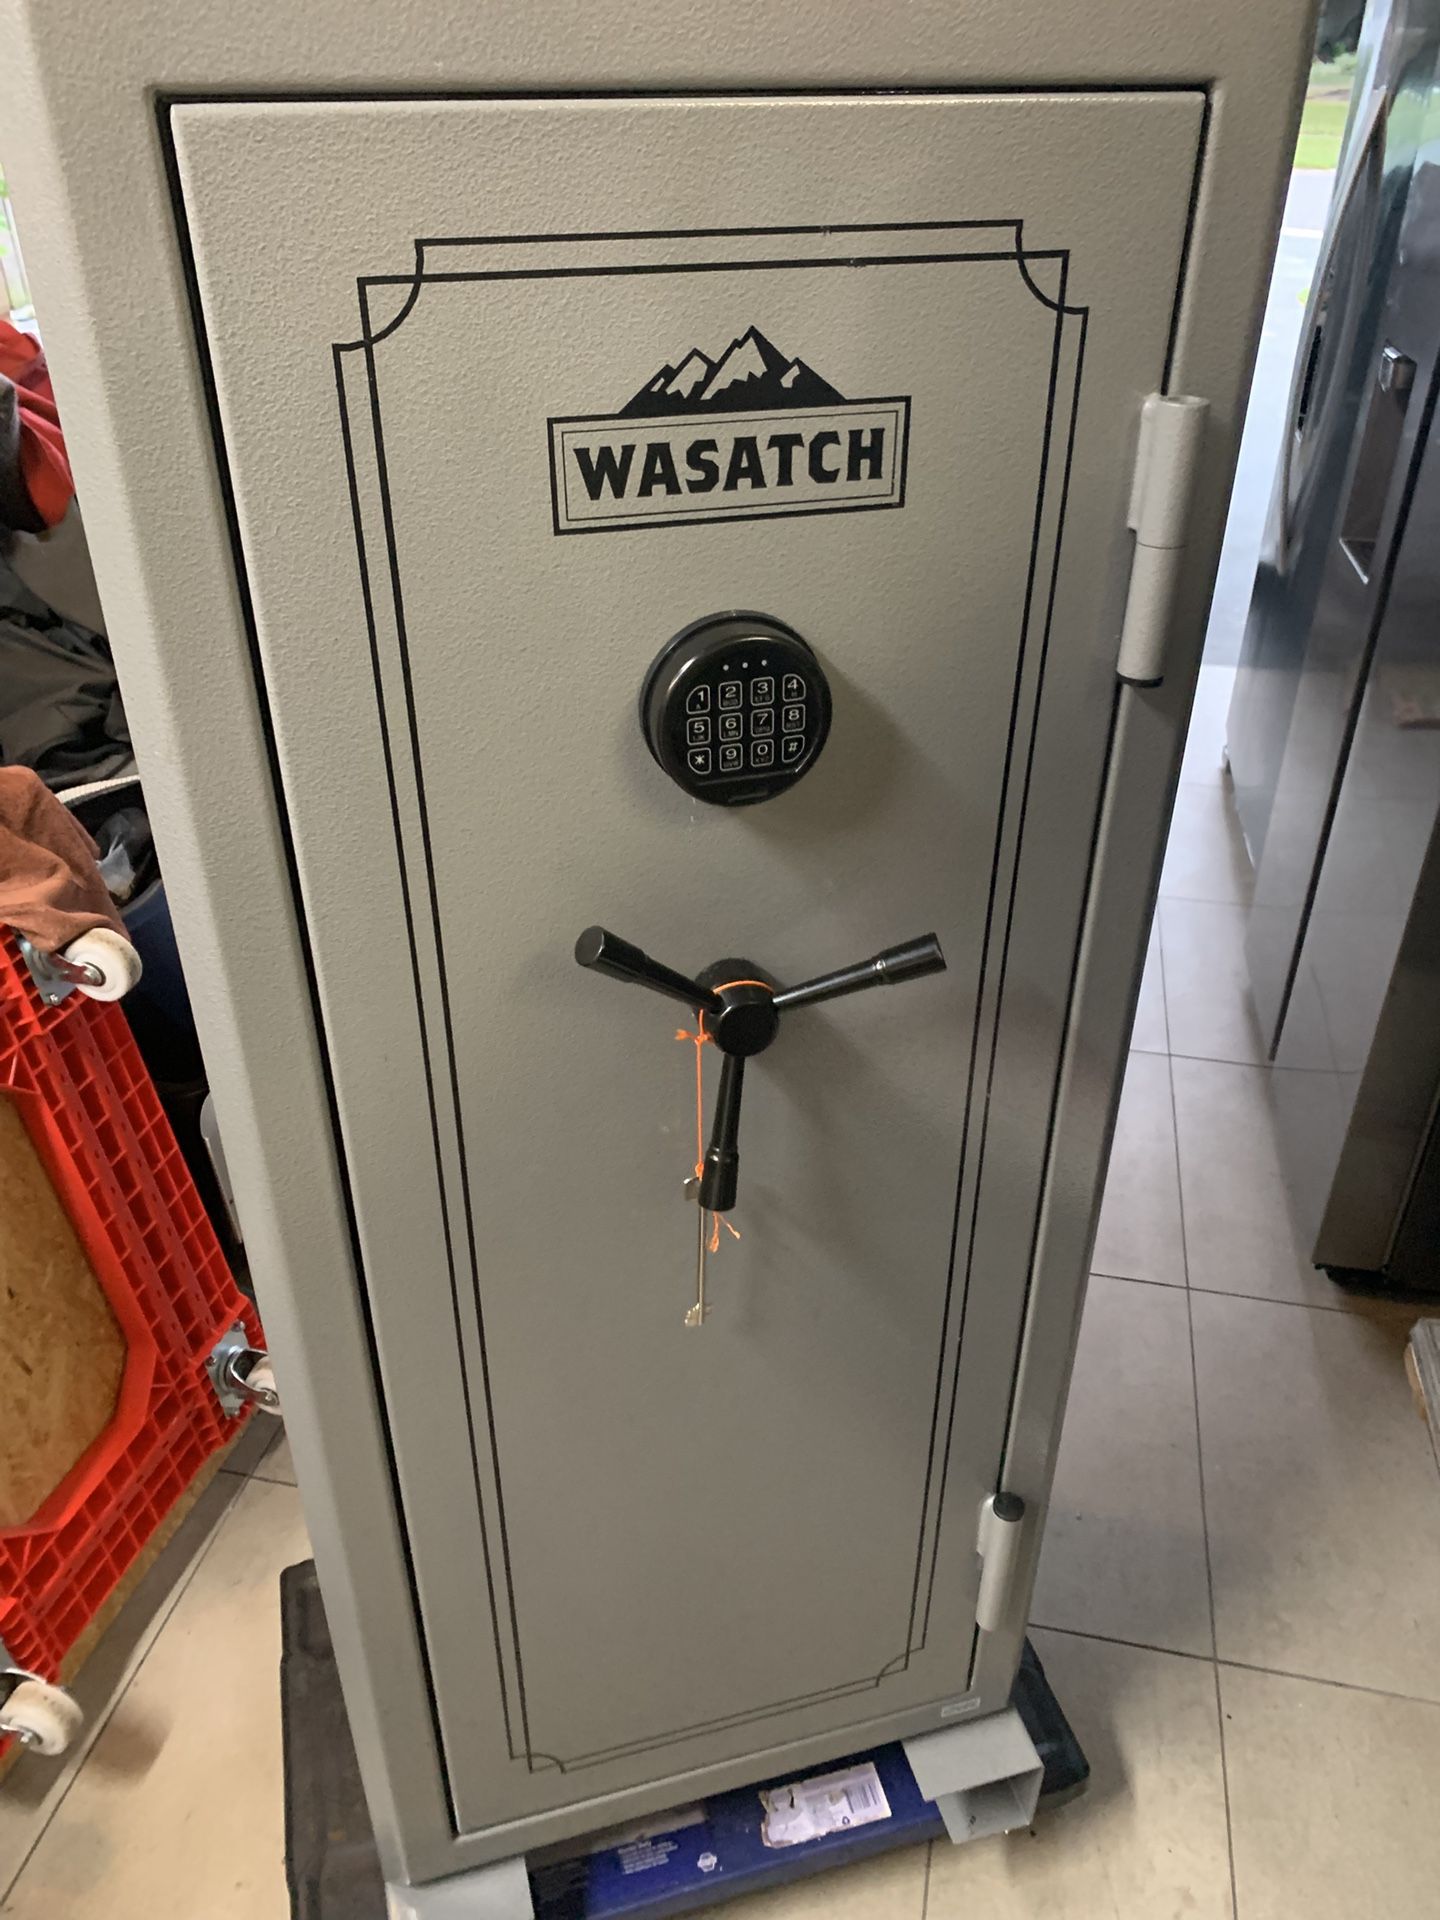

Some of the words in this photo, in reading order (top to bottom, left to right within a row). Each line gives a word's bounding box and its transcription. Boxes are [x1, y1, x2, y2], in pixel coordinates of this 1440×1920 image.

[573, 427, 886, 501] WASATCH
[697, 690, 704, 702] 1
[725, 686, 737, 698] 2
[757, 682, 769, 694] 3
[787, 679, 798, 690] 4
[693, 721, 705, 734] 5
[725, 717, 737, 730] 6
[757, 713, 769, 726] 7
[788, 709, 800, 721] 8
[725, 748, 737, 760] 9
[788, 742, 799, 752] #
